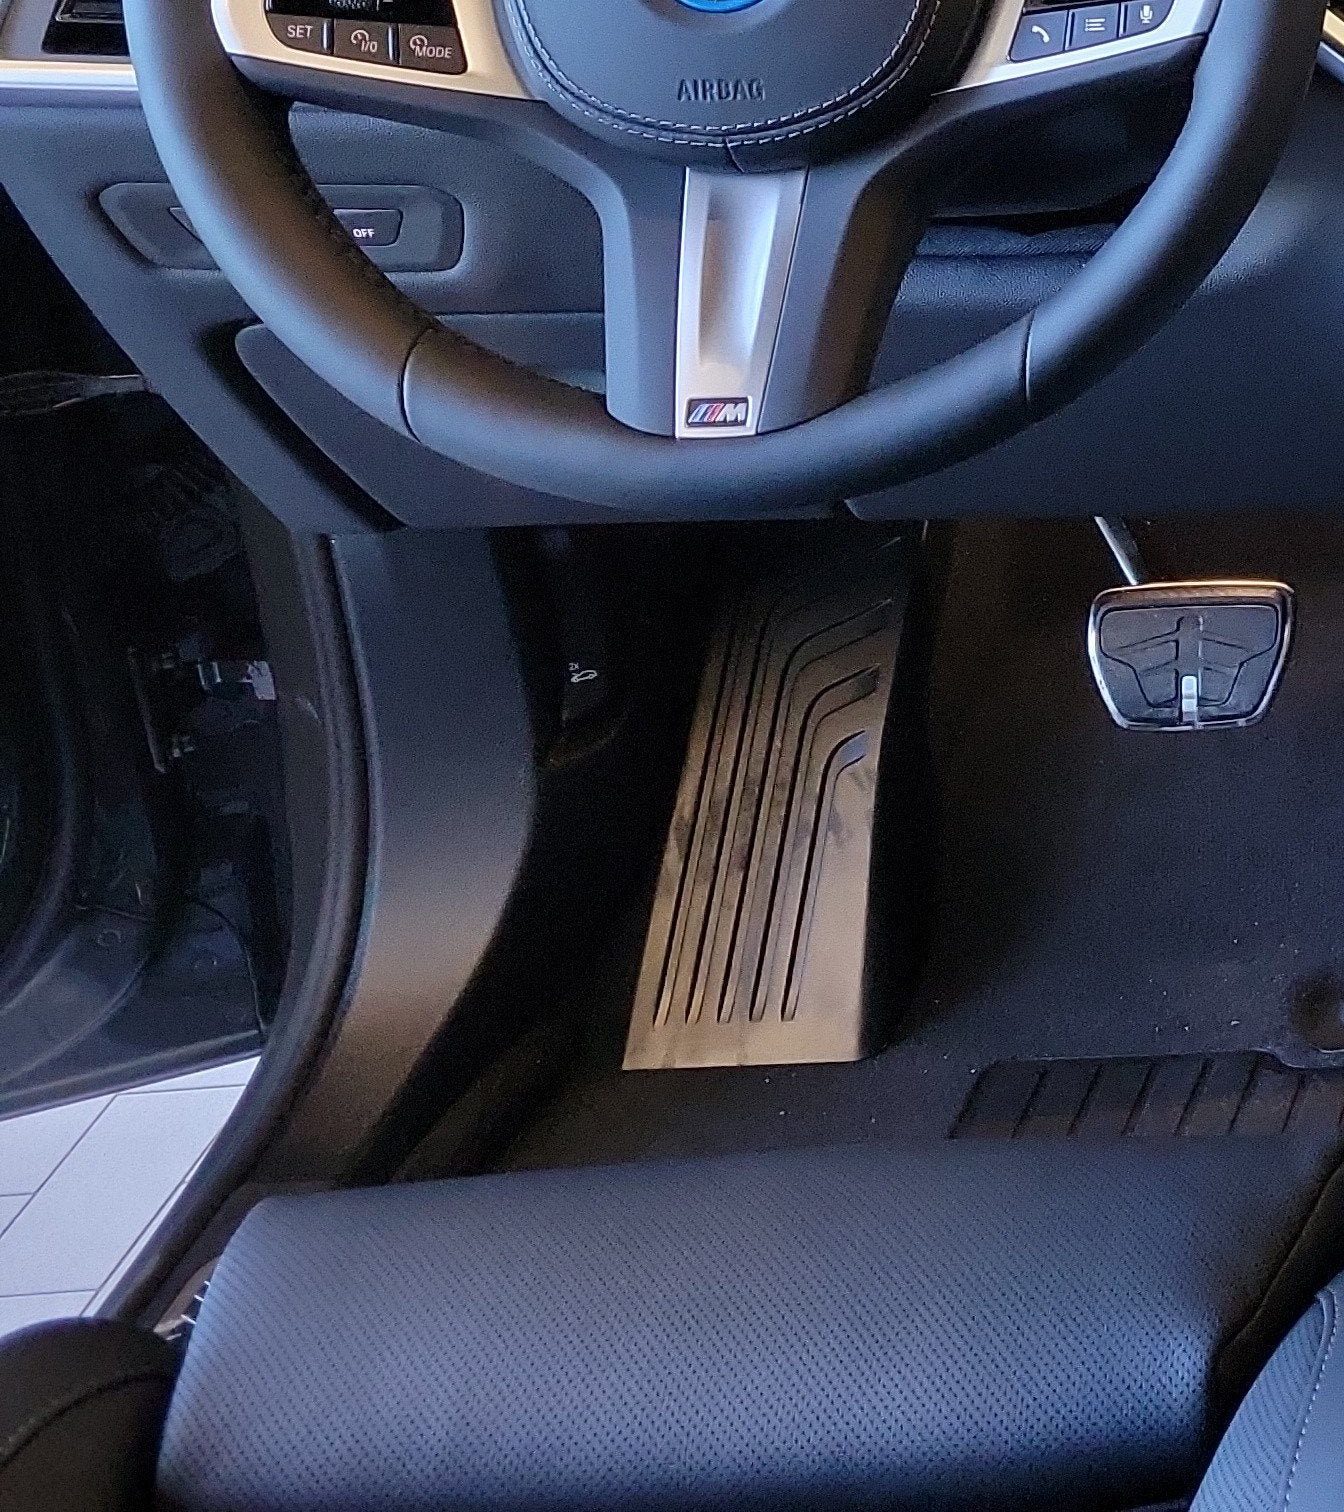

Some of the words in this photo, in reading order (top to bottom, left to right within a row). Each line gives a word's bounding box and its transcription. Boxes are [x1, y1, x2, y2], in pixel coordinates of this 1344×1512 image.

[286, 24, 314, 39] SET
[414, 44, 452, 59] MODE
[677, 78, 766, 102] AIRBAG
[353, 228, 375, 238] OFF
